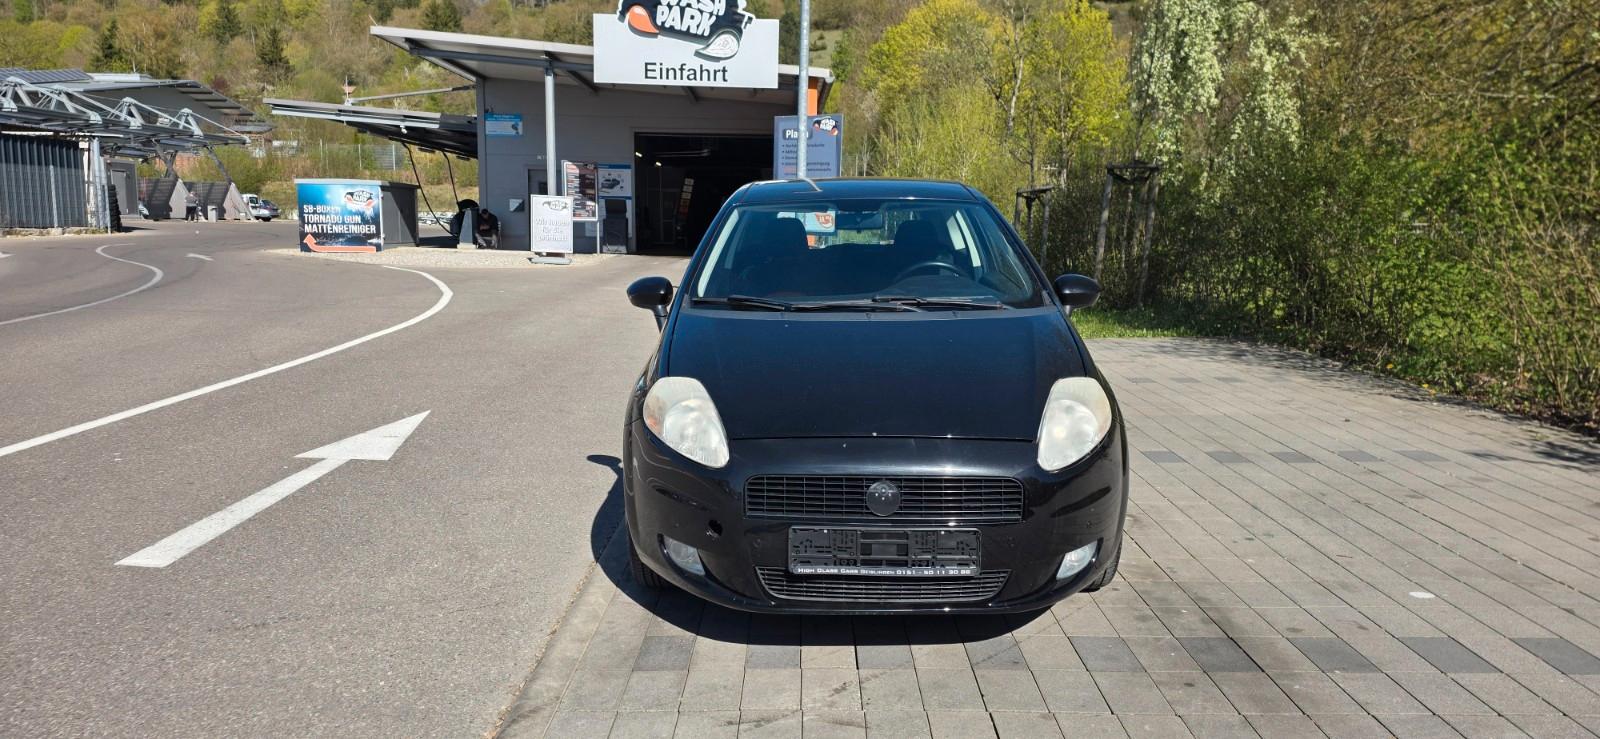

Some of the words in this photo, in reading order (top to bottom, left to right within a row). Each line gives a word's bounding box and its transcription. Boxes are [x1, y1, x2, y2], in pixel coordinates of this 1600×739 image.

[660, 0, 726, 16] SH
[656, 5, 716, 36] PARK
[644, 62, 728, 82] Einfahrt
[303, 205, 341, 213] SB-BOXEN
[303, 214, 342, 223] TORNADO
[344, 215, 361, 223] GUN
[304, 224, 377, 234] MATTENREINIGER
